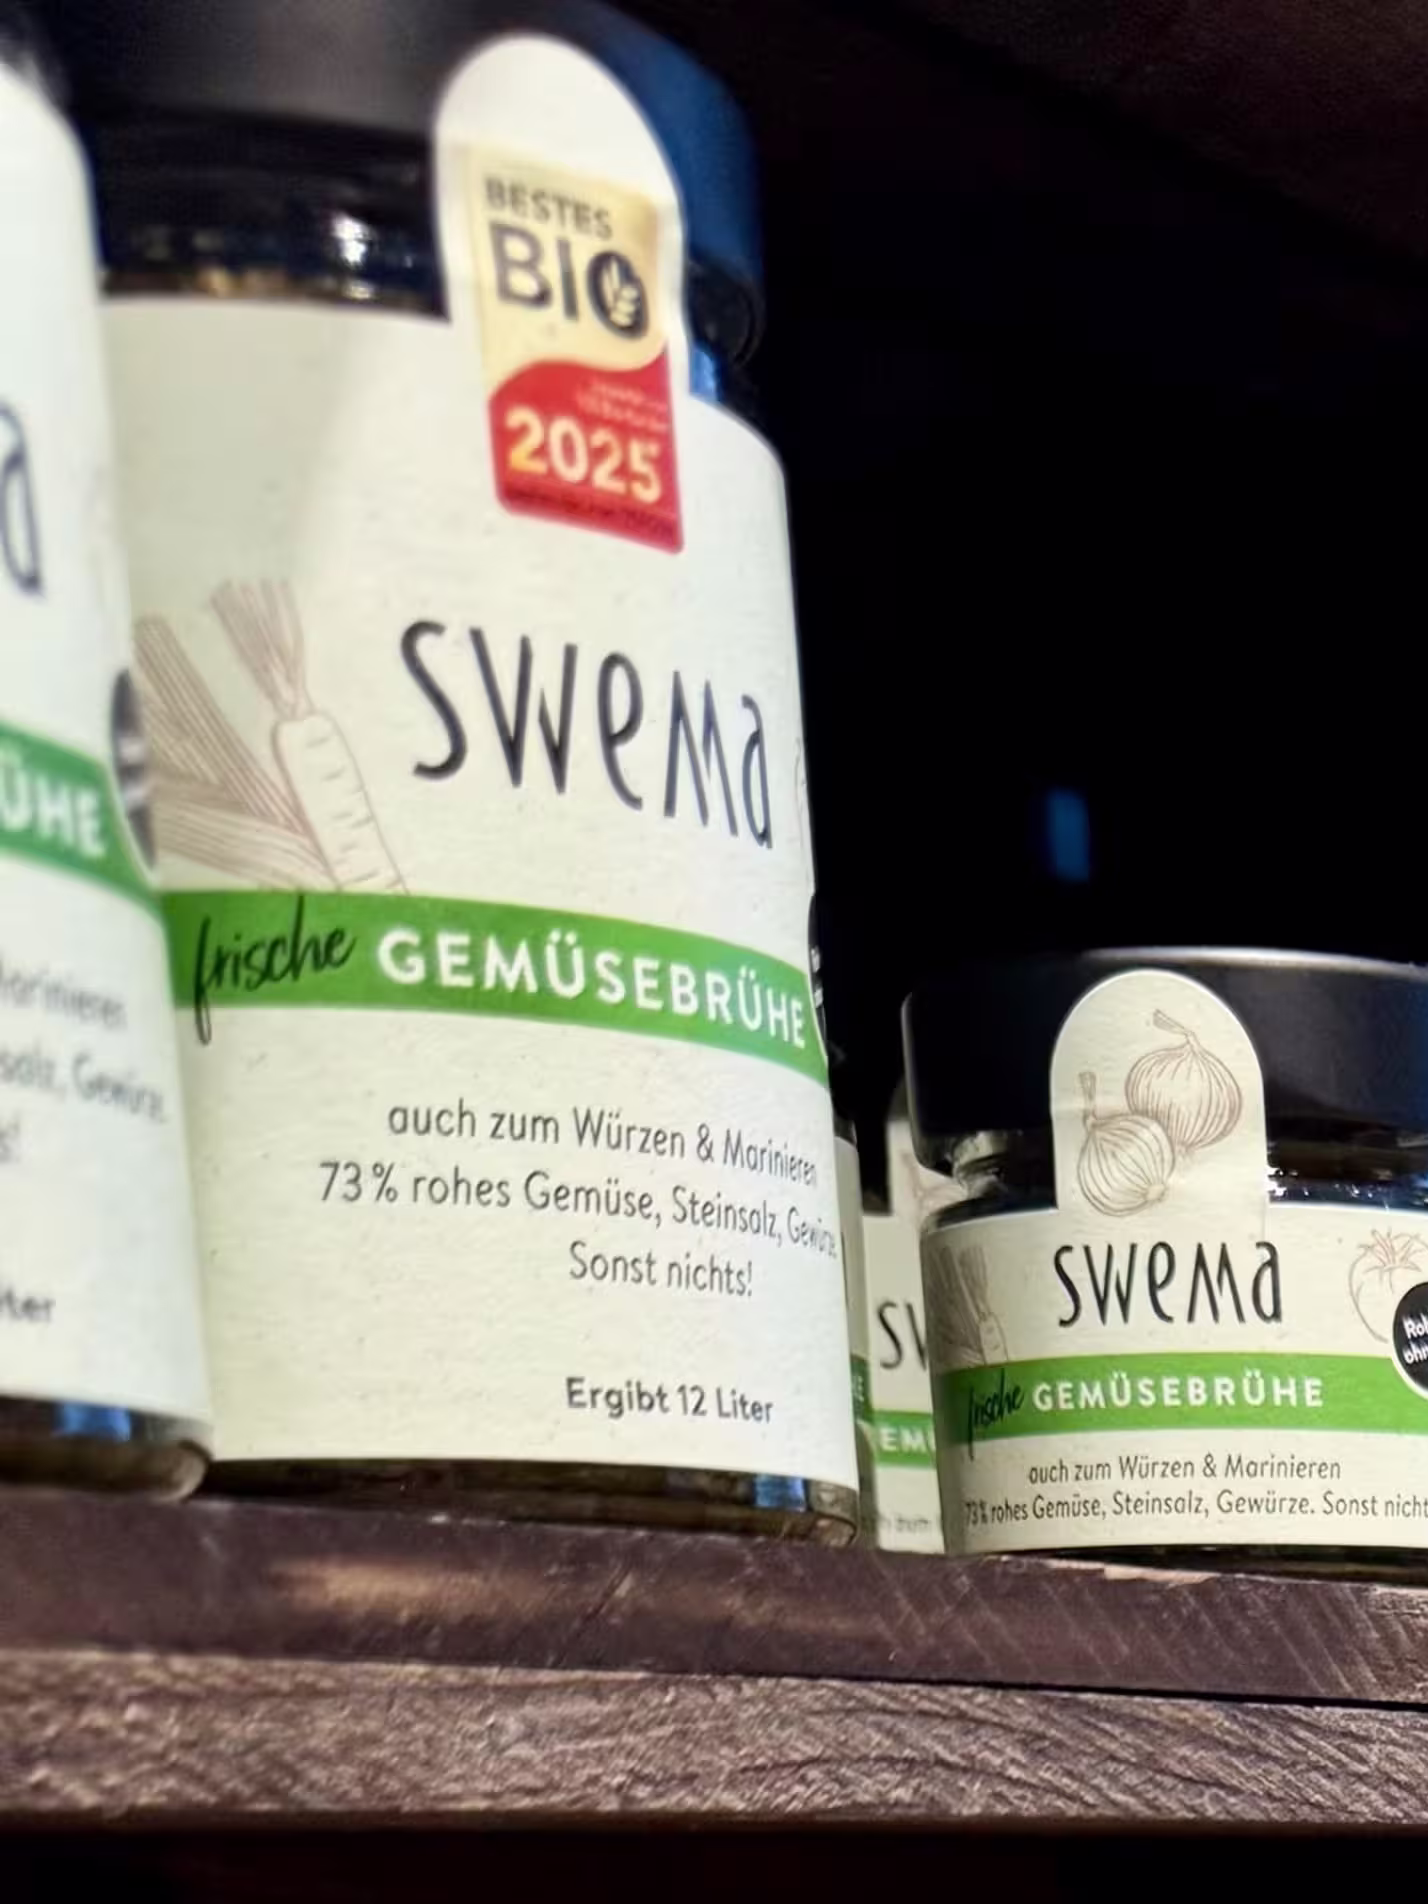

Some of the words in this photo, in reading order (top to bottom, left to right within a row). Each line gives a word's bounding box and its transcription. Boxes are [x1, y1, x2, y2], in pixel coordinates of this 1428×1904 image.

[484, 177, 613, 242] BESTES
[489, 219, 649, 340] BIO
[504, 406, 662, 505] 2025
[193, 895, 357, 1046] frische
[377, 928, 806, 1048] GEMÜSEBRÜHE
[387, 1096, 476, 1138] auch
[489, 1111, 560, 1145] zum
[572, 1105, 686, 1159] Würzen
[696, 1122, 715, 1163] &
[723, 1127, 818, 1188] Marinieren
[412, 1164, 512, 1208] rohes
[524, 1169, 661, 1230] Gemüse,
[672, 1184, 782, 1248] Steinsalz,
[569, 1239, 658, 1287] Sonst
[667, 1252, 753, 1298] nichts!
[565, 1376, 671, 1420] Ergibt
[677, 1384, 708, 1417] 12
[715, 1387, 774, 1424] Liter
[1032, 1368, 1324, 1412] GEMÜSEBRÜHE
[1028, 1459, 1069, 1485] auch
[1074, 1461, 1112, 1481] zum
[1118, 1454, 1195, 1480] Würzen
[1202, 1452, 1217, 1478] &
[1224, 1453, 1341, 1480] Marinieren
[990, 1498, 1029, 1523] rohes
[1032, 1493, 1106, 1521] Gemüse,
[1112, 1489, 1209, 1518] Steinsalz,
[1216, 1488, 1316, 1516] Gewürze.
[1322, 1490, 1379, 1516] Sonst
